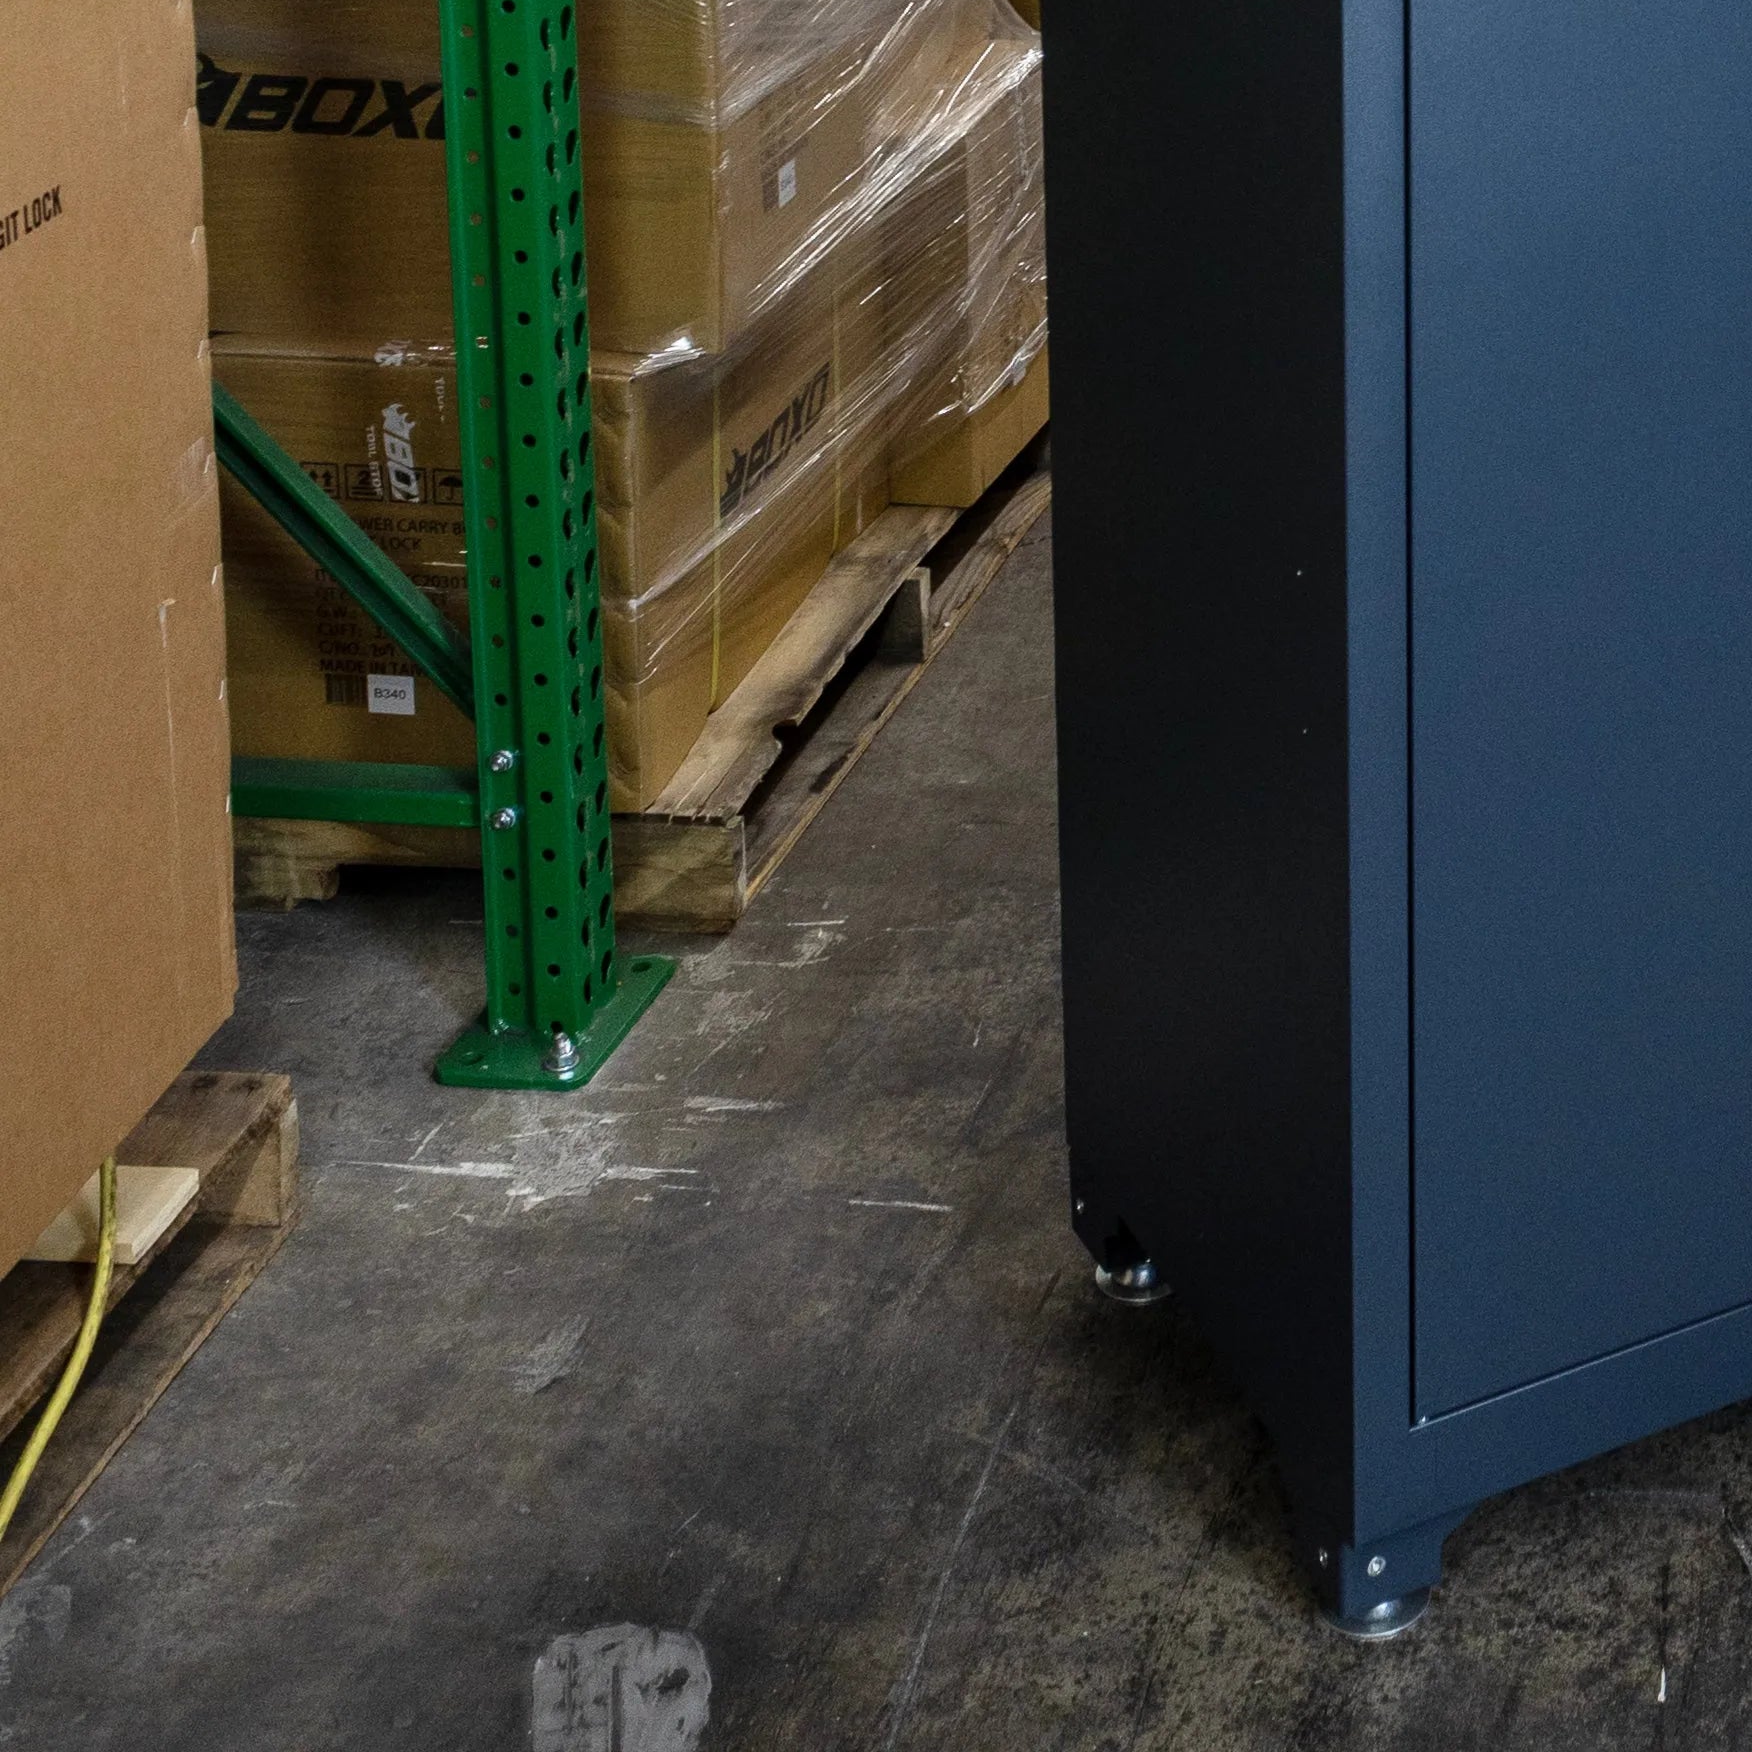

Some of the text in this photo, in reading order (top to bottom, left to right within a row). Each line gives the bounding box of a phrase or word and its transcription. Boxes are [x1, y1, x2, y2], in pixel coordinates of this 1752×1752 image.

[223, 73, 447, 140] BOX
[23, 183, 63, 235] LOCK
[396, 518, 449, 536] CARRY
[373, 687, 407, 700] B340
